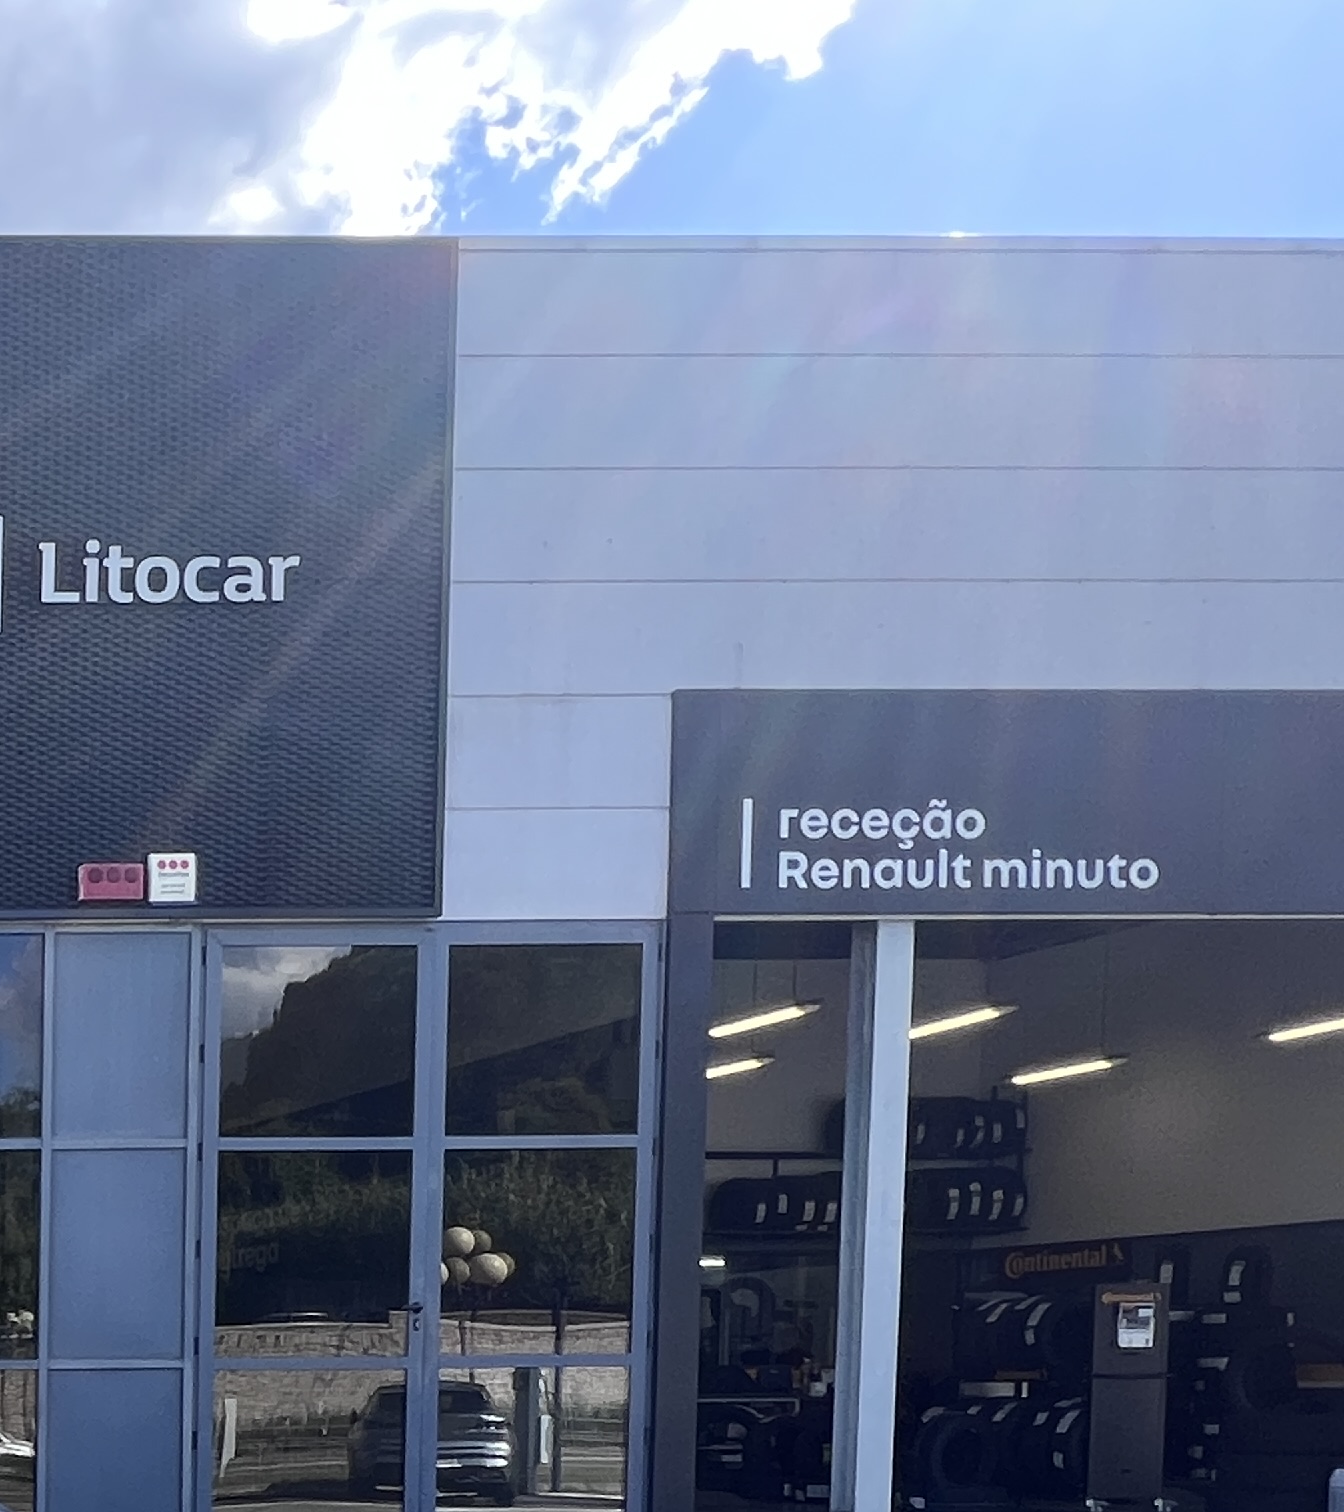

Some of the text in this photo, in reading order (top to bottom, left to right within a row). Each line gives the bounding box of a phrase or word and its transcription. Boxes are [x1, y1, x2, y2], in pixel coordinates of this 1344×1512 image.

[38, 539, 301, 604] Litocar
[778, 798, 986, 849] receção
[778, 849, 1160, 889] Renault minuto
[1005, 1243, 1108, 1279] Continental
